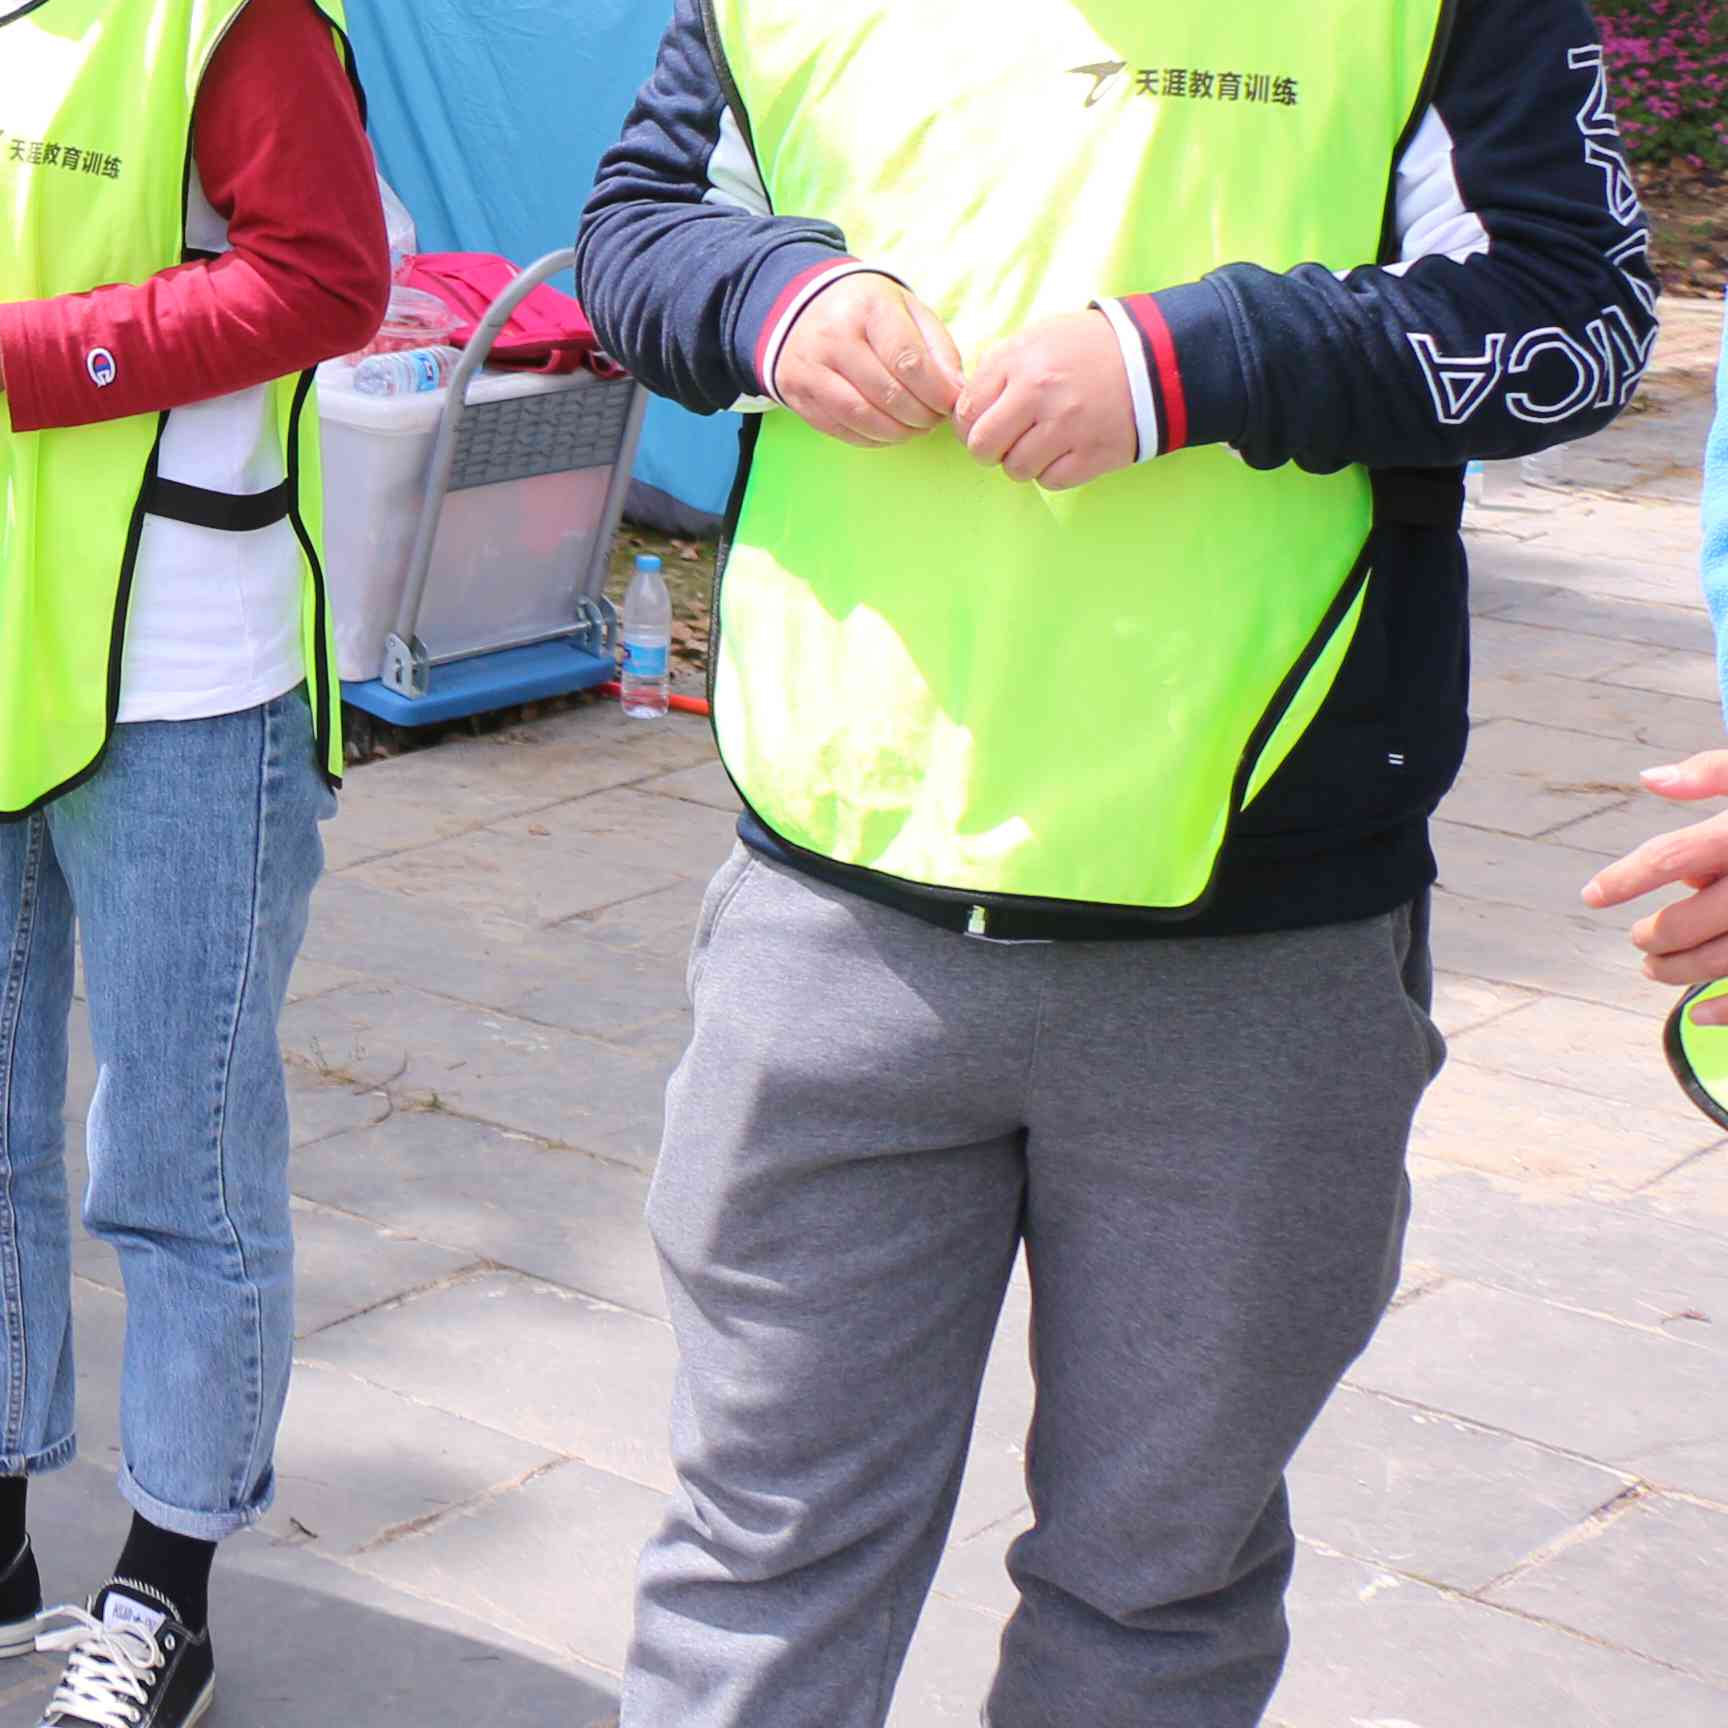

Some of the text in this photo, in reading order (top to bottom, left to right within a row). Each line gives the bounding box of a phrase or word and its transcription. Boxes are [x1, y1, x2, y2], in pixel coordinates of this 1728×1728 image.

[1136, 68, 1299, 106] 天涯教育训练
[10, 138, 122, 179] 天涯教育训练
